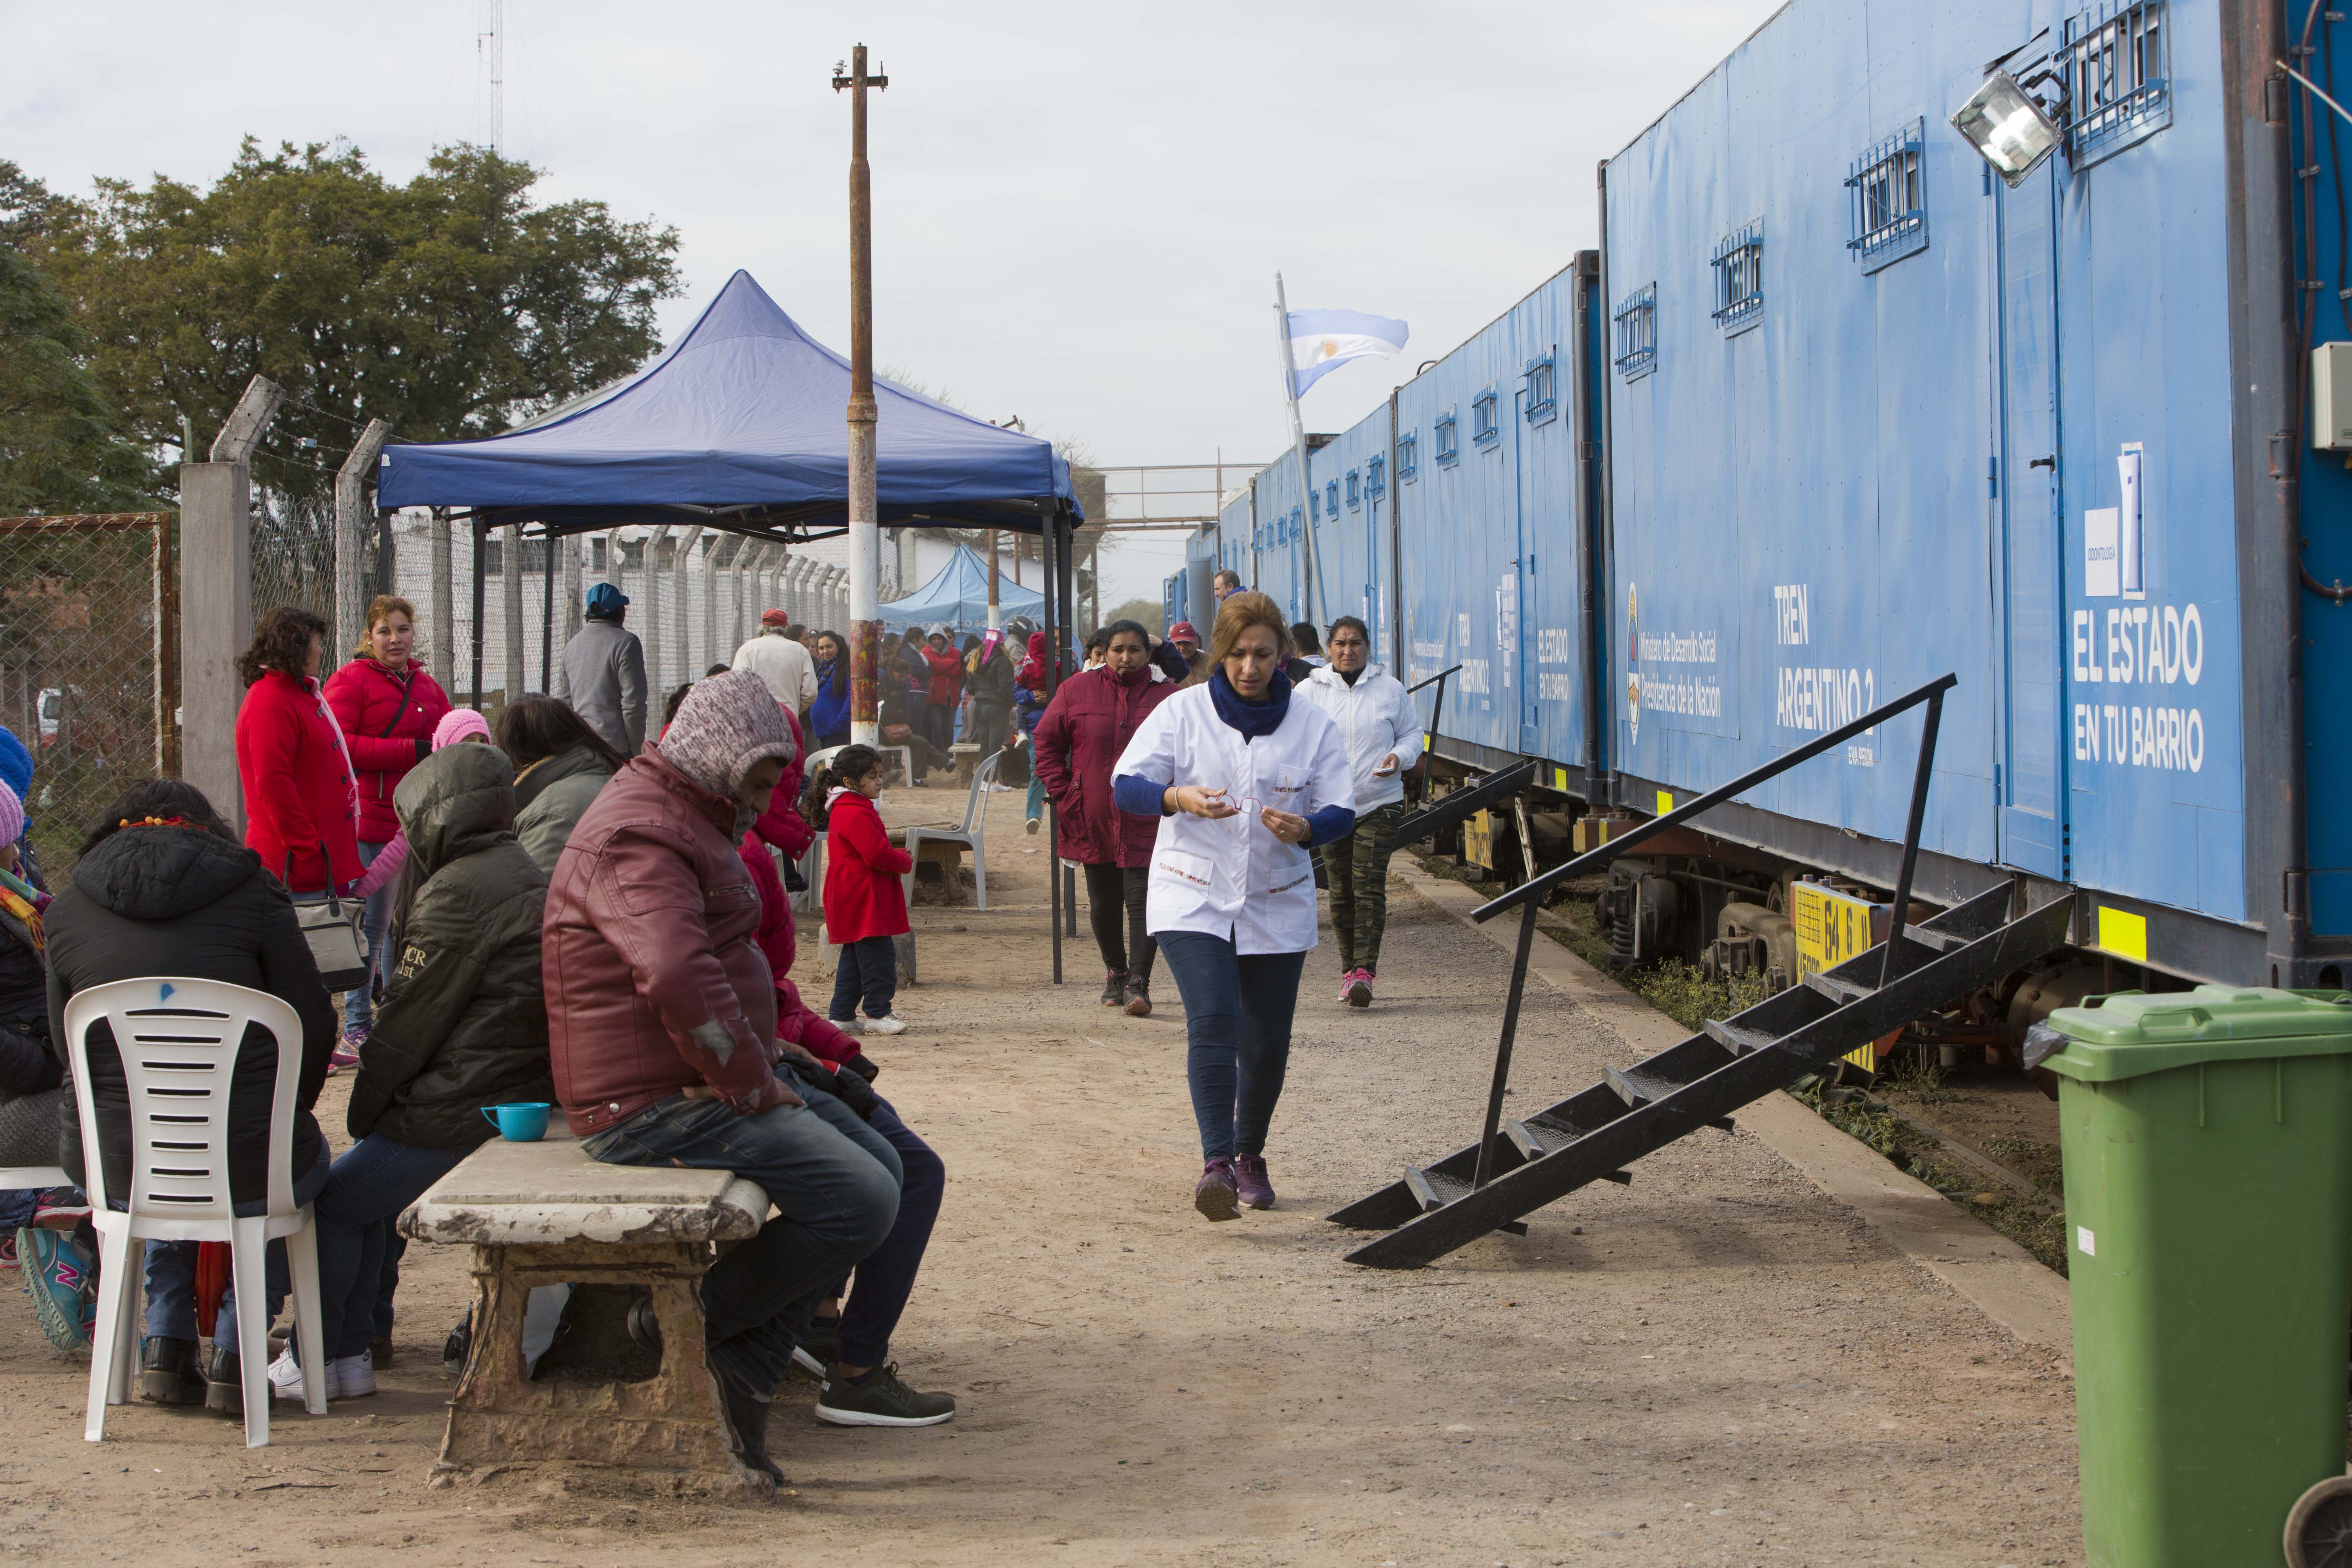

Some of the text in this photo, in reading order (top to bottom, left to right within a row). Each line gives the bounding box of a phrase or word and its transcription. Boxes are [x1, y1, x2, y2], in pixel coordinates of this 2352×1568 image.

[2088, 543, 2115, 561] ODONTOLOGÍA
[1774, 584, 1809, 645] TREN
[1539, 629, 1546, 663] EL
[1546, 628, 1568, 664] ESTADO
[1641, 630, 1716, 663] Ministerio de Desarrollo Social
[2074, 603, 2203, 686] EL ESTADO
[1459, 658, 1485, 694] ARGENTINO
[1486, 659, 1490, 694] 2
[1540, 673, 1546, 699] EN
[1552, 673, 1568, 702] BARRIO
[1642, 673, 1720, 717] Presidencia de la Nación
[1777, 667, 1873, 735] ARGENTINO 2
[1849, 743, 1873, 767] EVA PERÓN
[2075, 704, 2203, 773] EN TU BARRIO
[1846, 906, 1853, 956] 6
[398, 960, 415, 978] 1st
